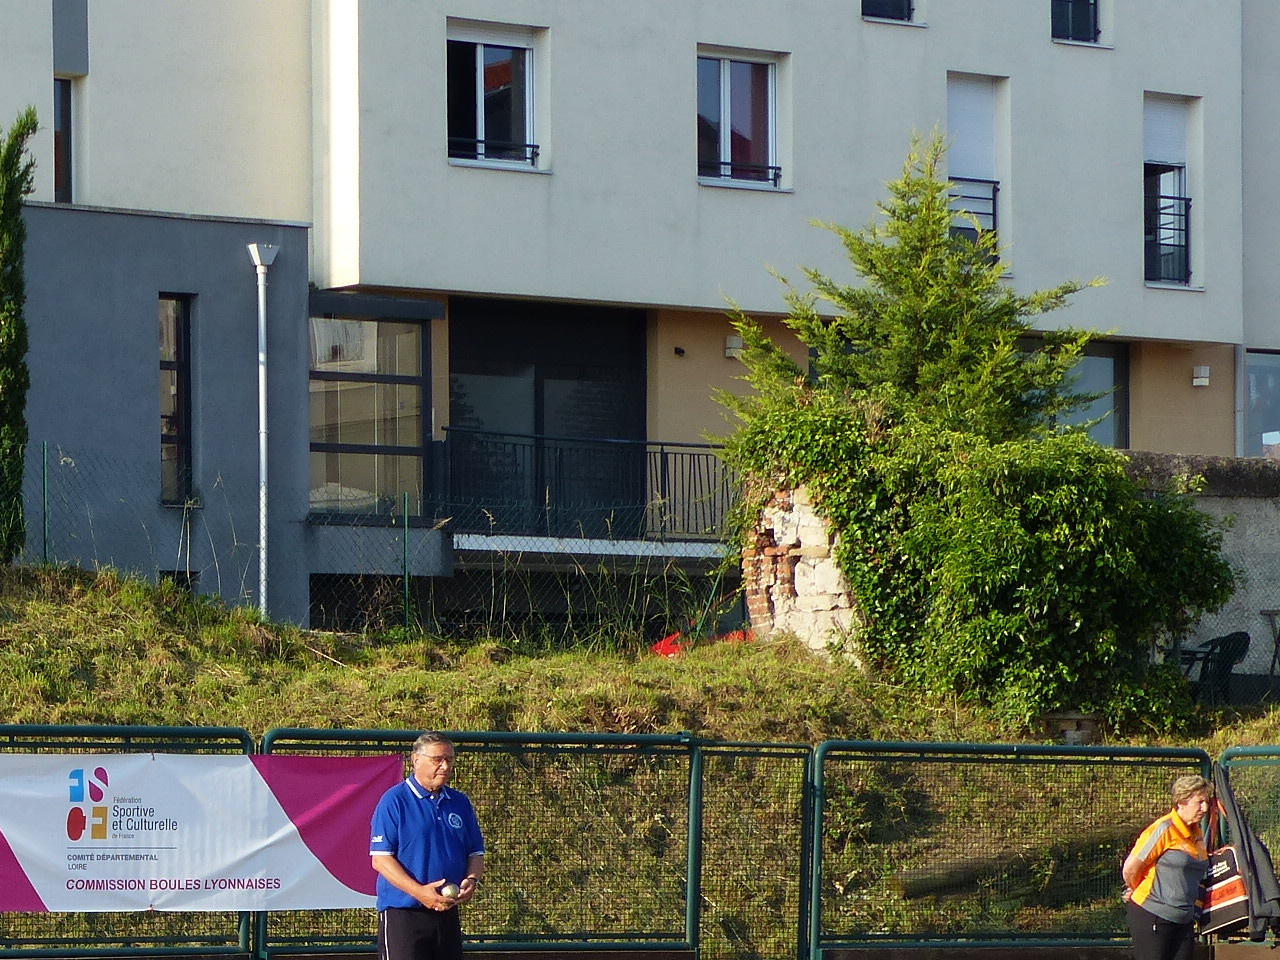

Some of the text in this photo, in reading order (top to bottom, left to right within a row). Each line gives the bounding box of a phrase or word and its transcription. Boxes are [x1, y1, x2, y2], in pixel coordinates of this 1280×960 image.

[112, 804, 155, 818] Sportive
[112, 818, 178, 831] et Culturelle
[67, 853, 159, 861] COMITÉ DÉPARTEMENTAL
[67, 863, 88, 871] LOIRE
[66, 878, 281, 891] COMMISSION BOULES LYONNAISES
